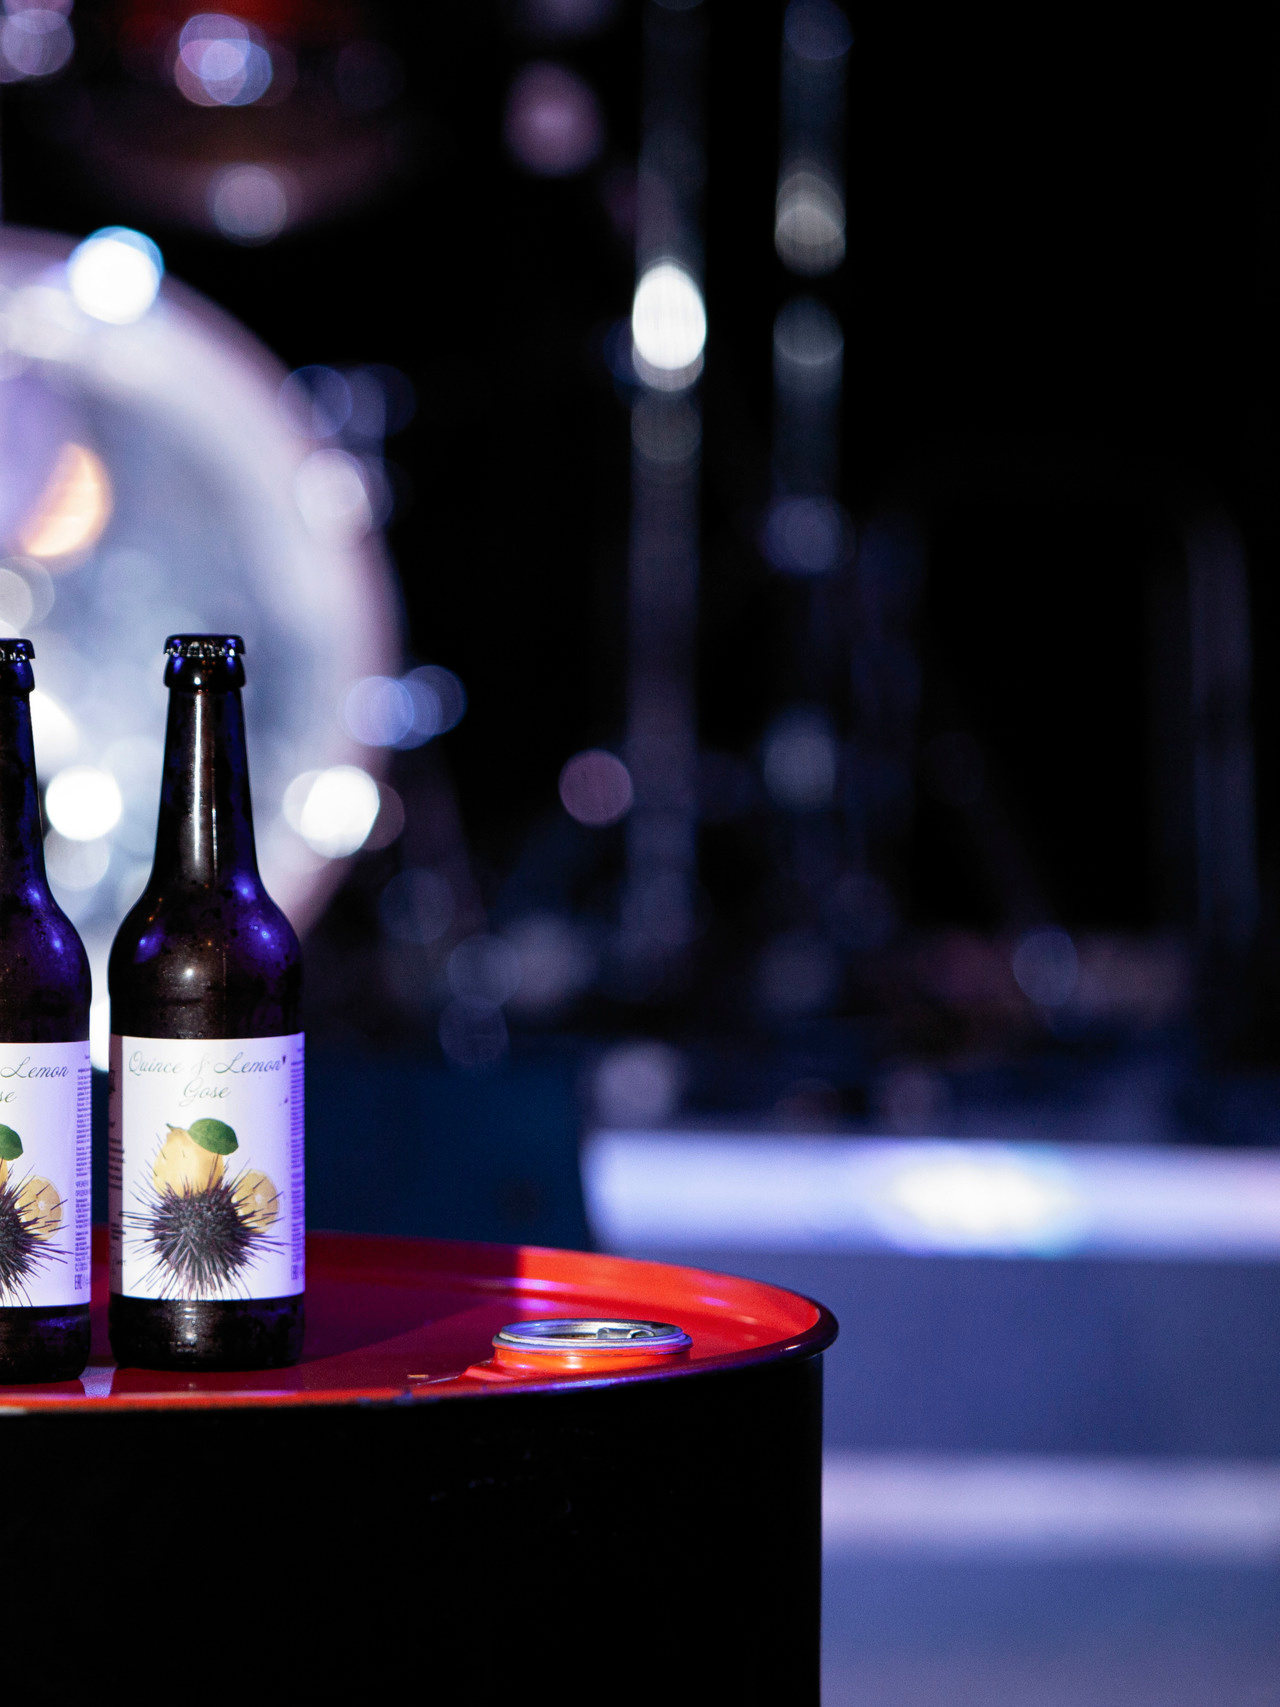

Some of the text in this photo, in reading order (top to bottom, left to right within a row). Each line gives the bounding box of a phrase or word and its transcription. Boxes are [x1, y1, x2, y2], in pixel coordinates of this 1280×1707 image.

[0, 1056, 68, 1079] Lemon
[128, 1051, 183, 1076] Quince
[213, 1052, 282, 1074] Lemon
[179, 1077, 231, 1107] Gose
